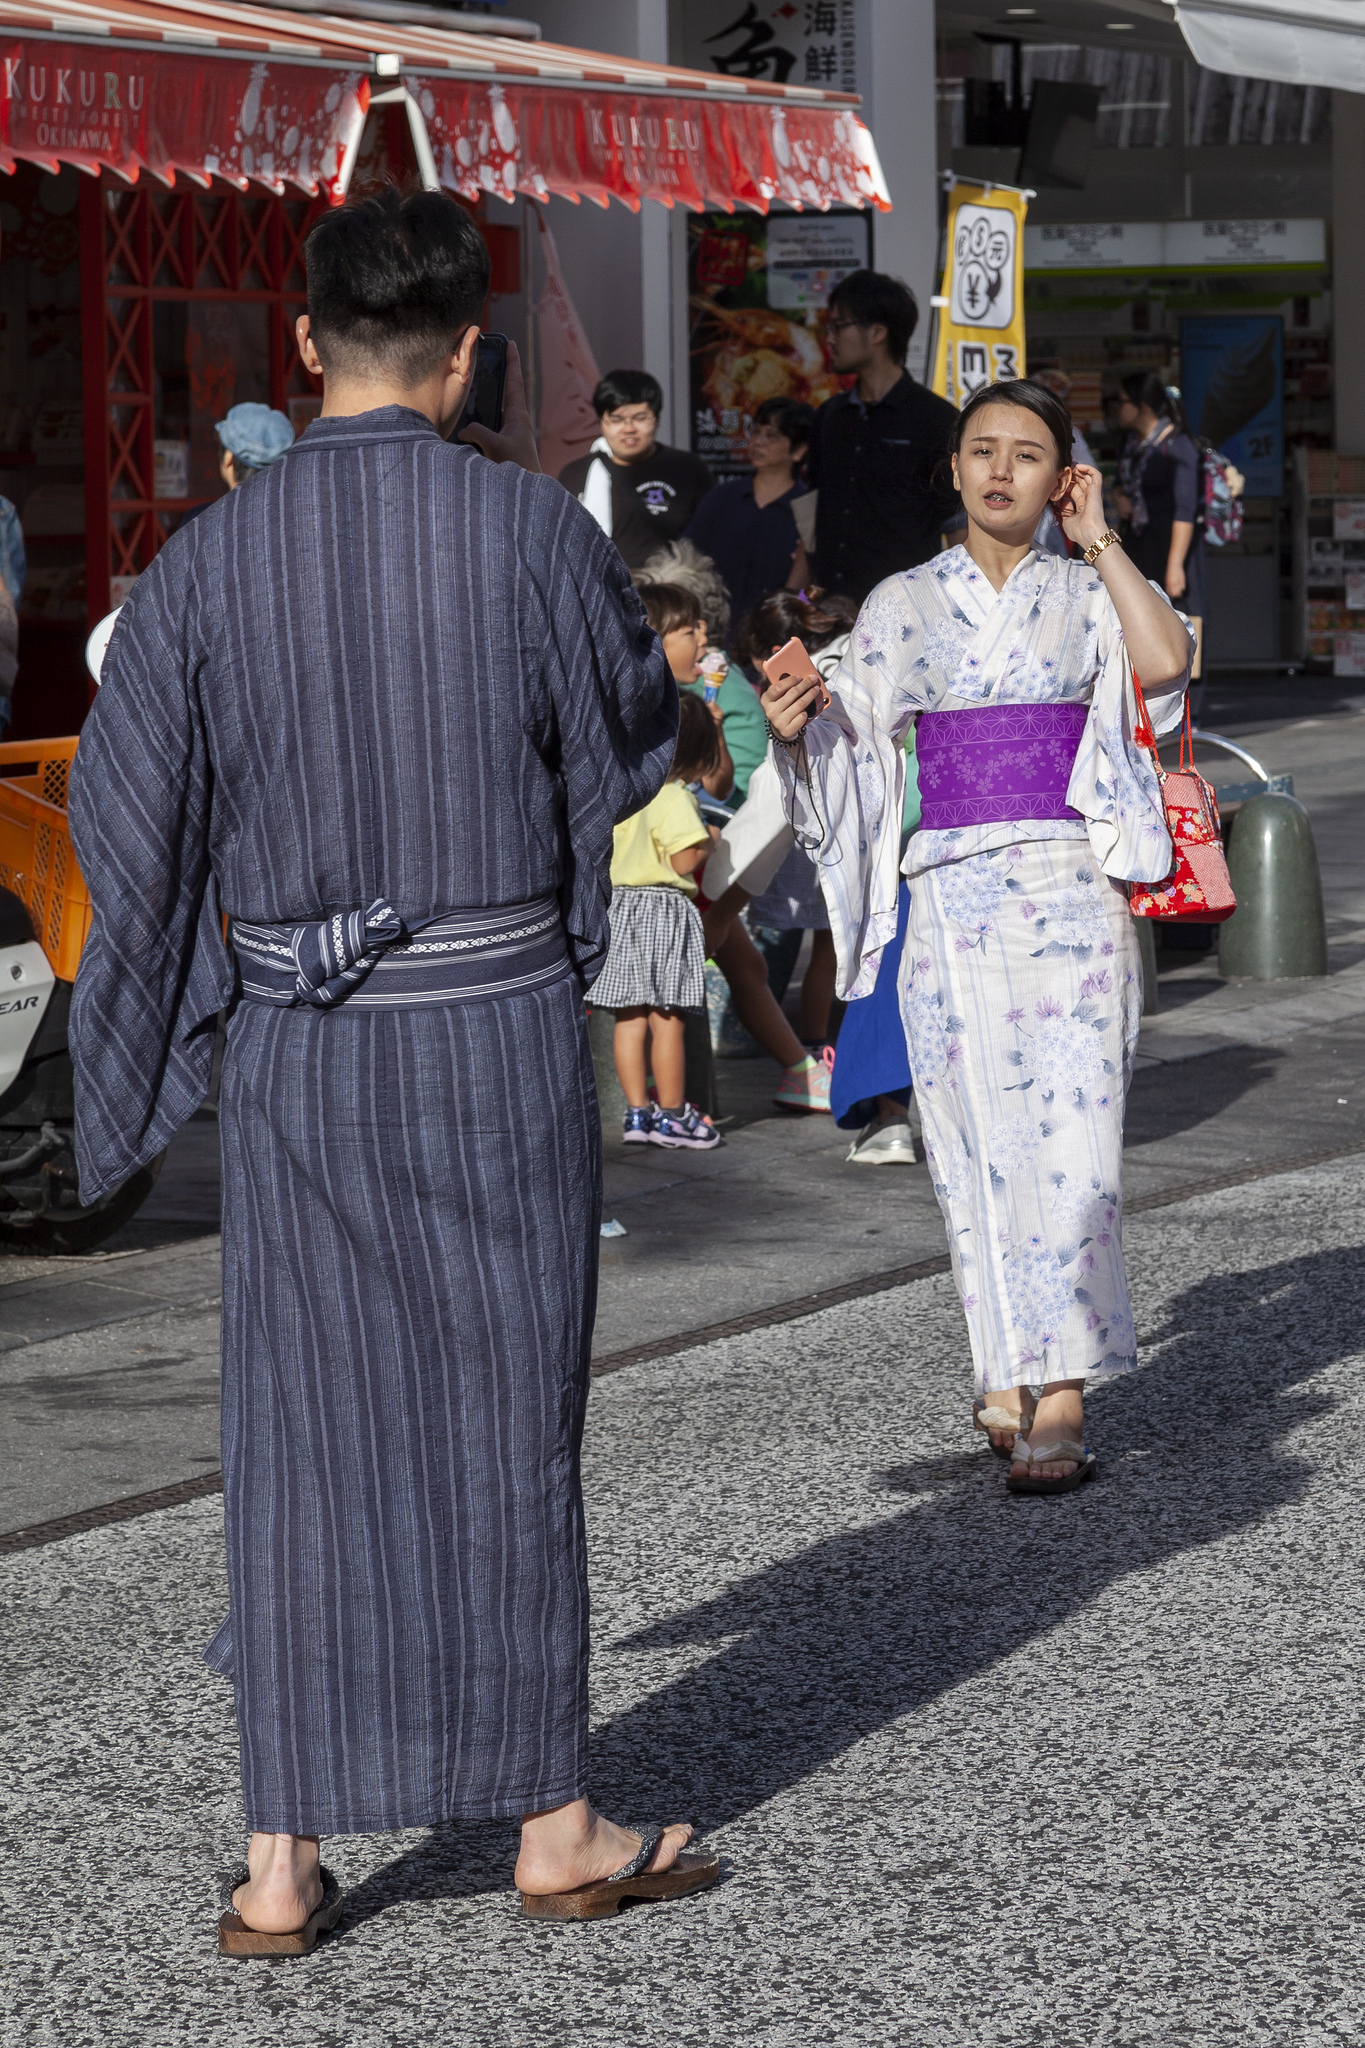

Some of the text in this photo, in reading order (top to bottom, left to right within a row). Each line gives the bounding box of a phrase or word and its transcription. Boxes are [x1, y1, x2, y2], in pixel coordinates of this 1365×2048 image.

[804, 0, 838, 82] 海鮮
[5, 57, 145, 111] KUKURU
[37, 122, 113, 151] OKINAWA
[591, 109, 700, 151] KUKURU
[1249, 434, 1275, 459] 2F
